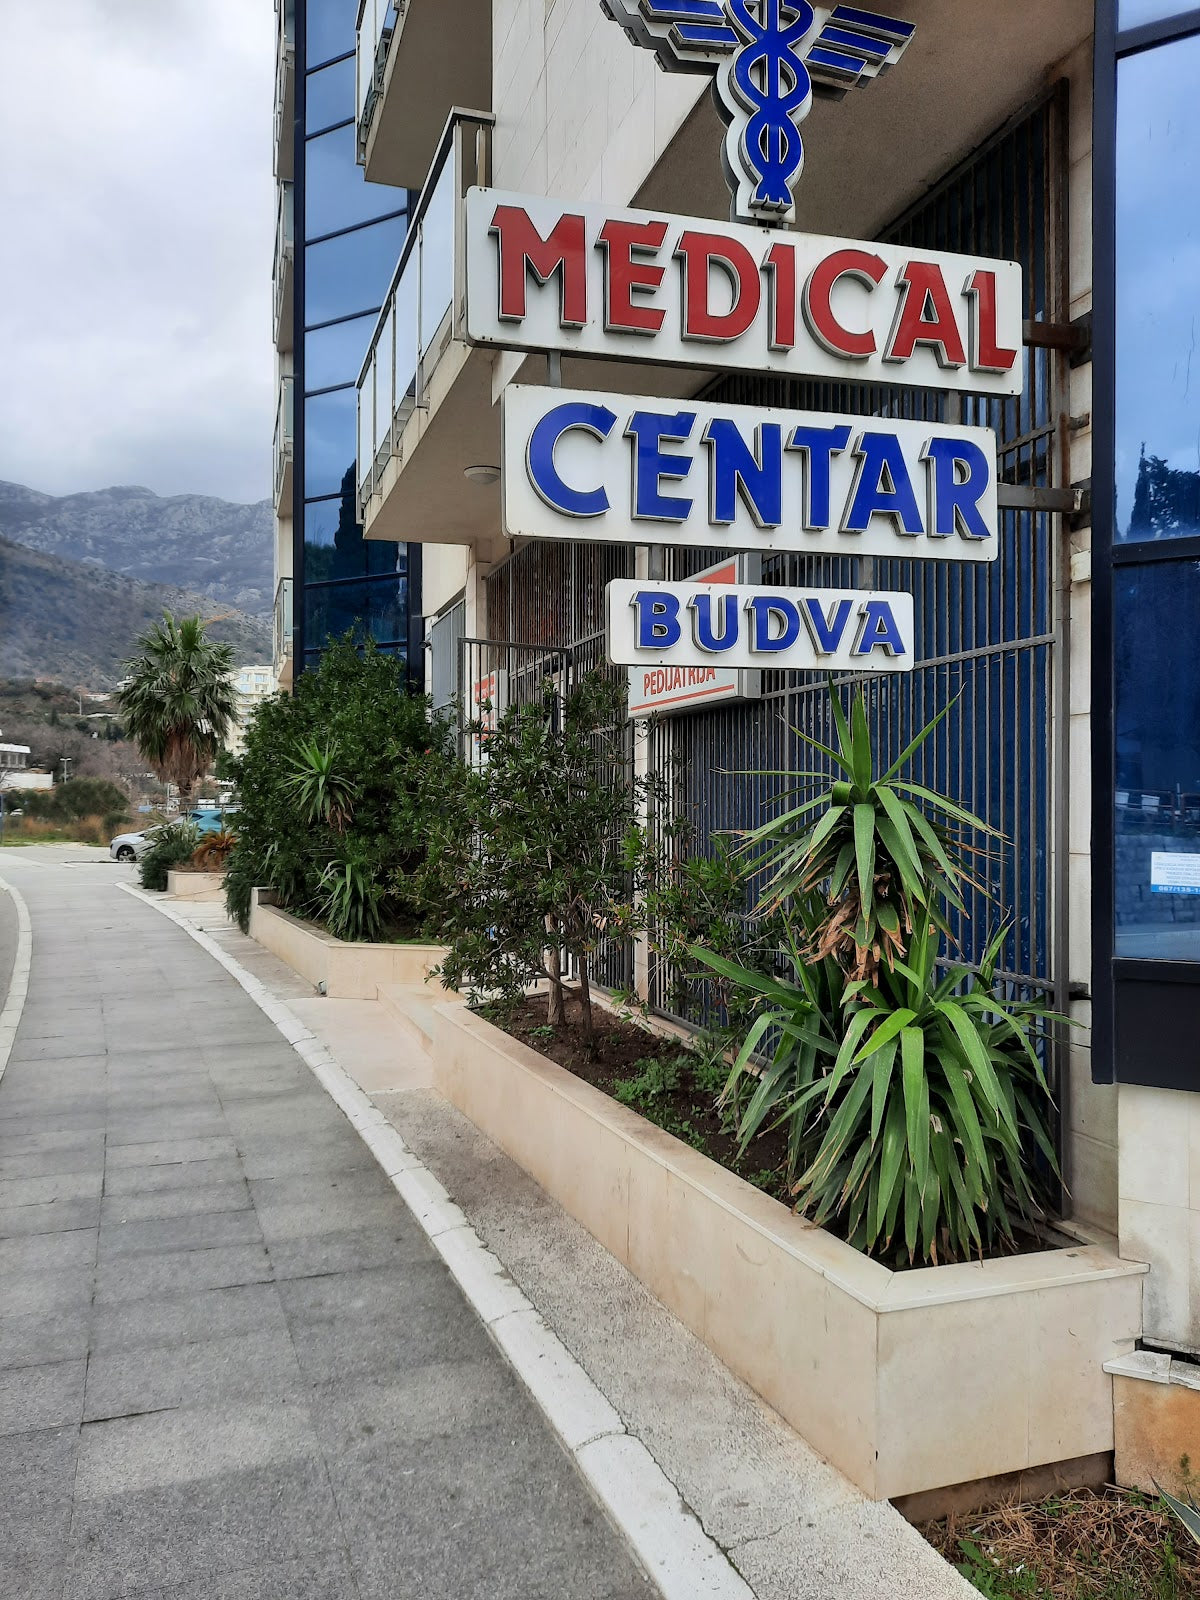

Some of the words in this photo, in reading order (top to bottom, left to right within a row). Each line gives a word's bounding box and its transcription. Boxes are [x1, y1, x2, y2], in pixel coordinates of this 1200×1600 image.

[489, 205, 1018, 373] MEDICAL
[526, 402, 992, 540] CENTAR
[630, 591, 906, 657] BUDVA
